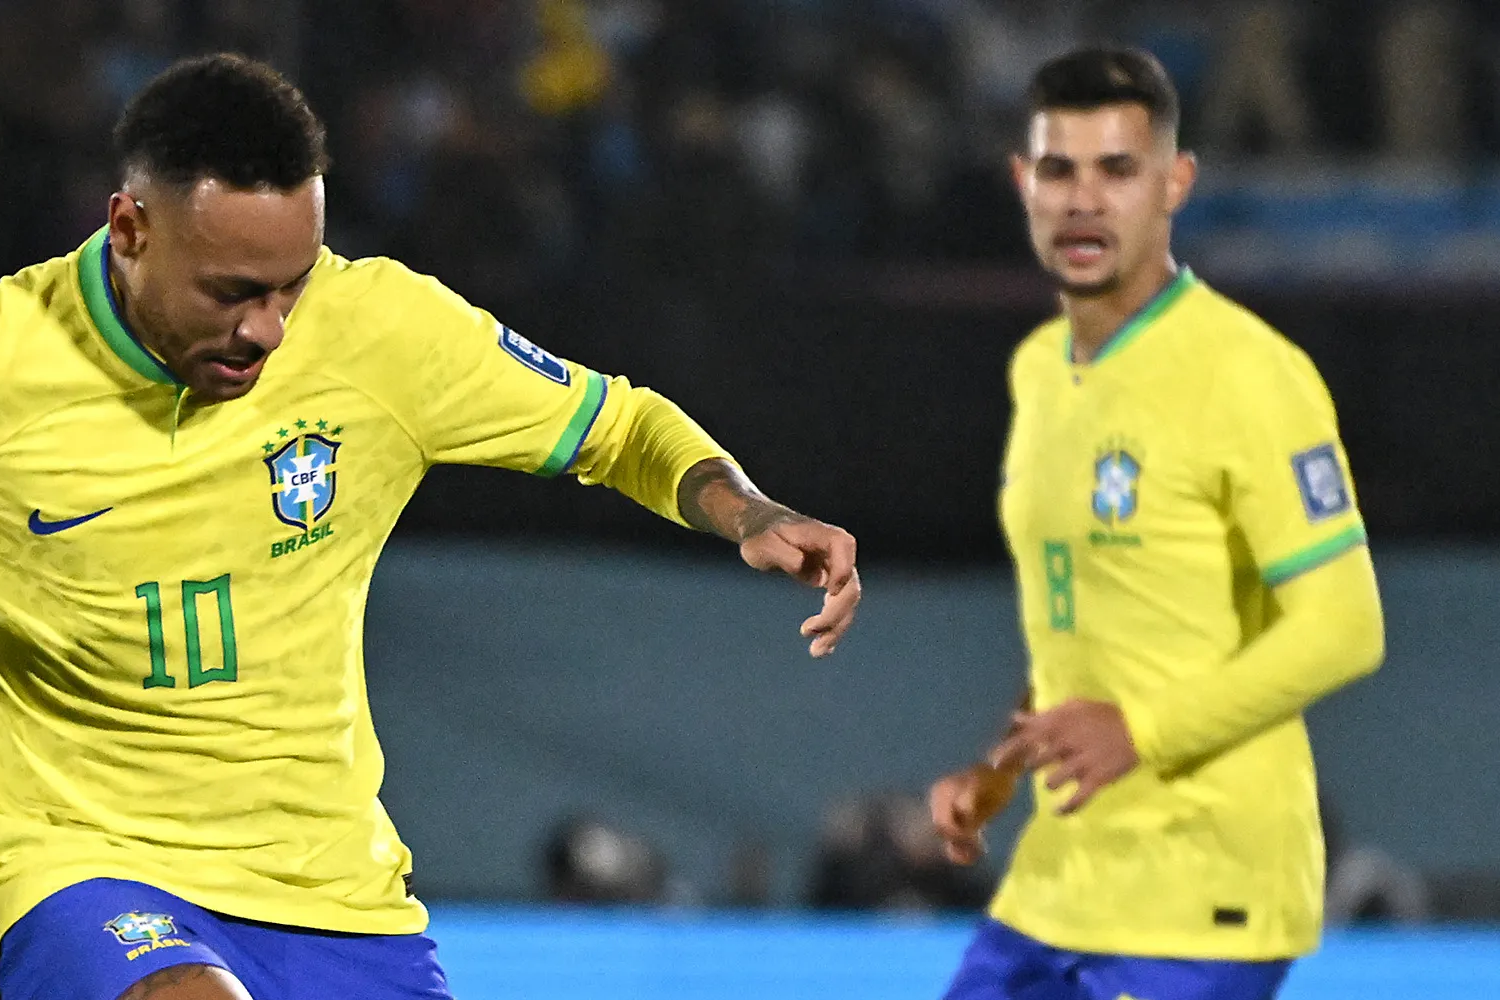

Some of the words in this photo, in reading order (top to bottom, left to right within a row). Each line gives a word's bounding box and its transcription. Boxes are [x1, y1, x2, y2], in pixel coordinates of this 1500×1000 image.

[291, 470, 317, 486] CBF
[271, 521, 334, 558] BRASIL
[1043, 539, 1076, 633] 8
[135, 573, 238, 689] 10
